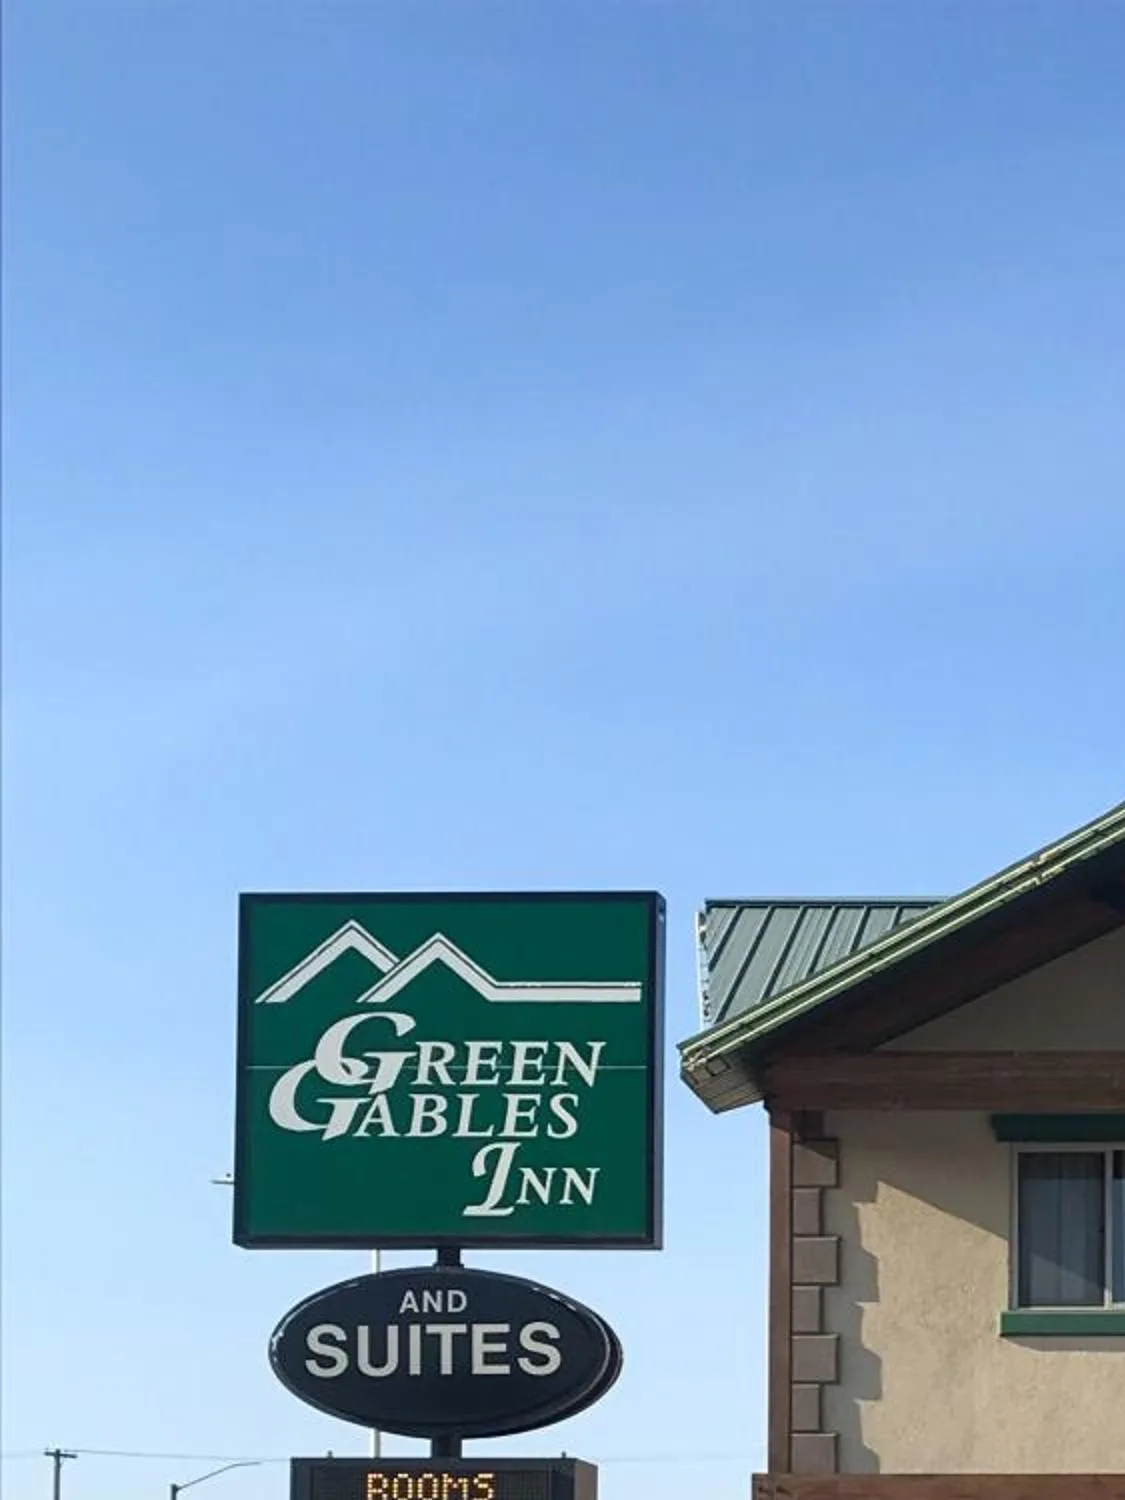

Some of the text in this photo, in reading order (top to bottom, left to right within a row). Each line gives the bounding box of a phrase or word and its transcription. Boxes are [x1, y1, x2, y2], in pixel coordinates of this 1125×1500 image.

[315, 1011, 607, 1095] GREEN
[268, 1056, 580, 1141] GABLES
[462, 1141, 601, 1217] INN
[400, 1289, 467, 1313] AND
[305, 1321, 562, 1378] SUITES
